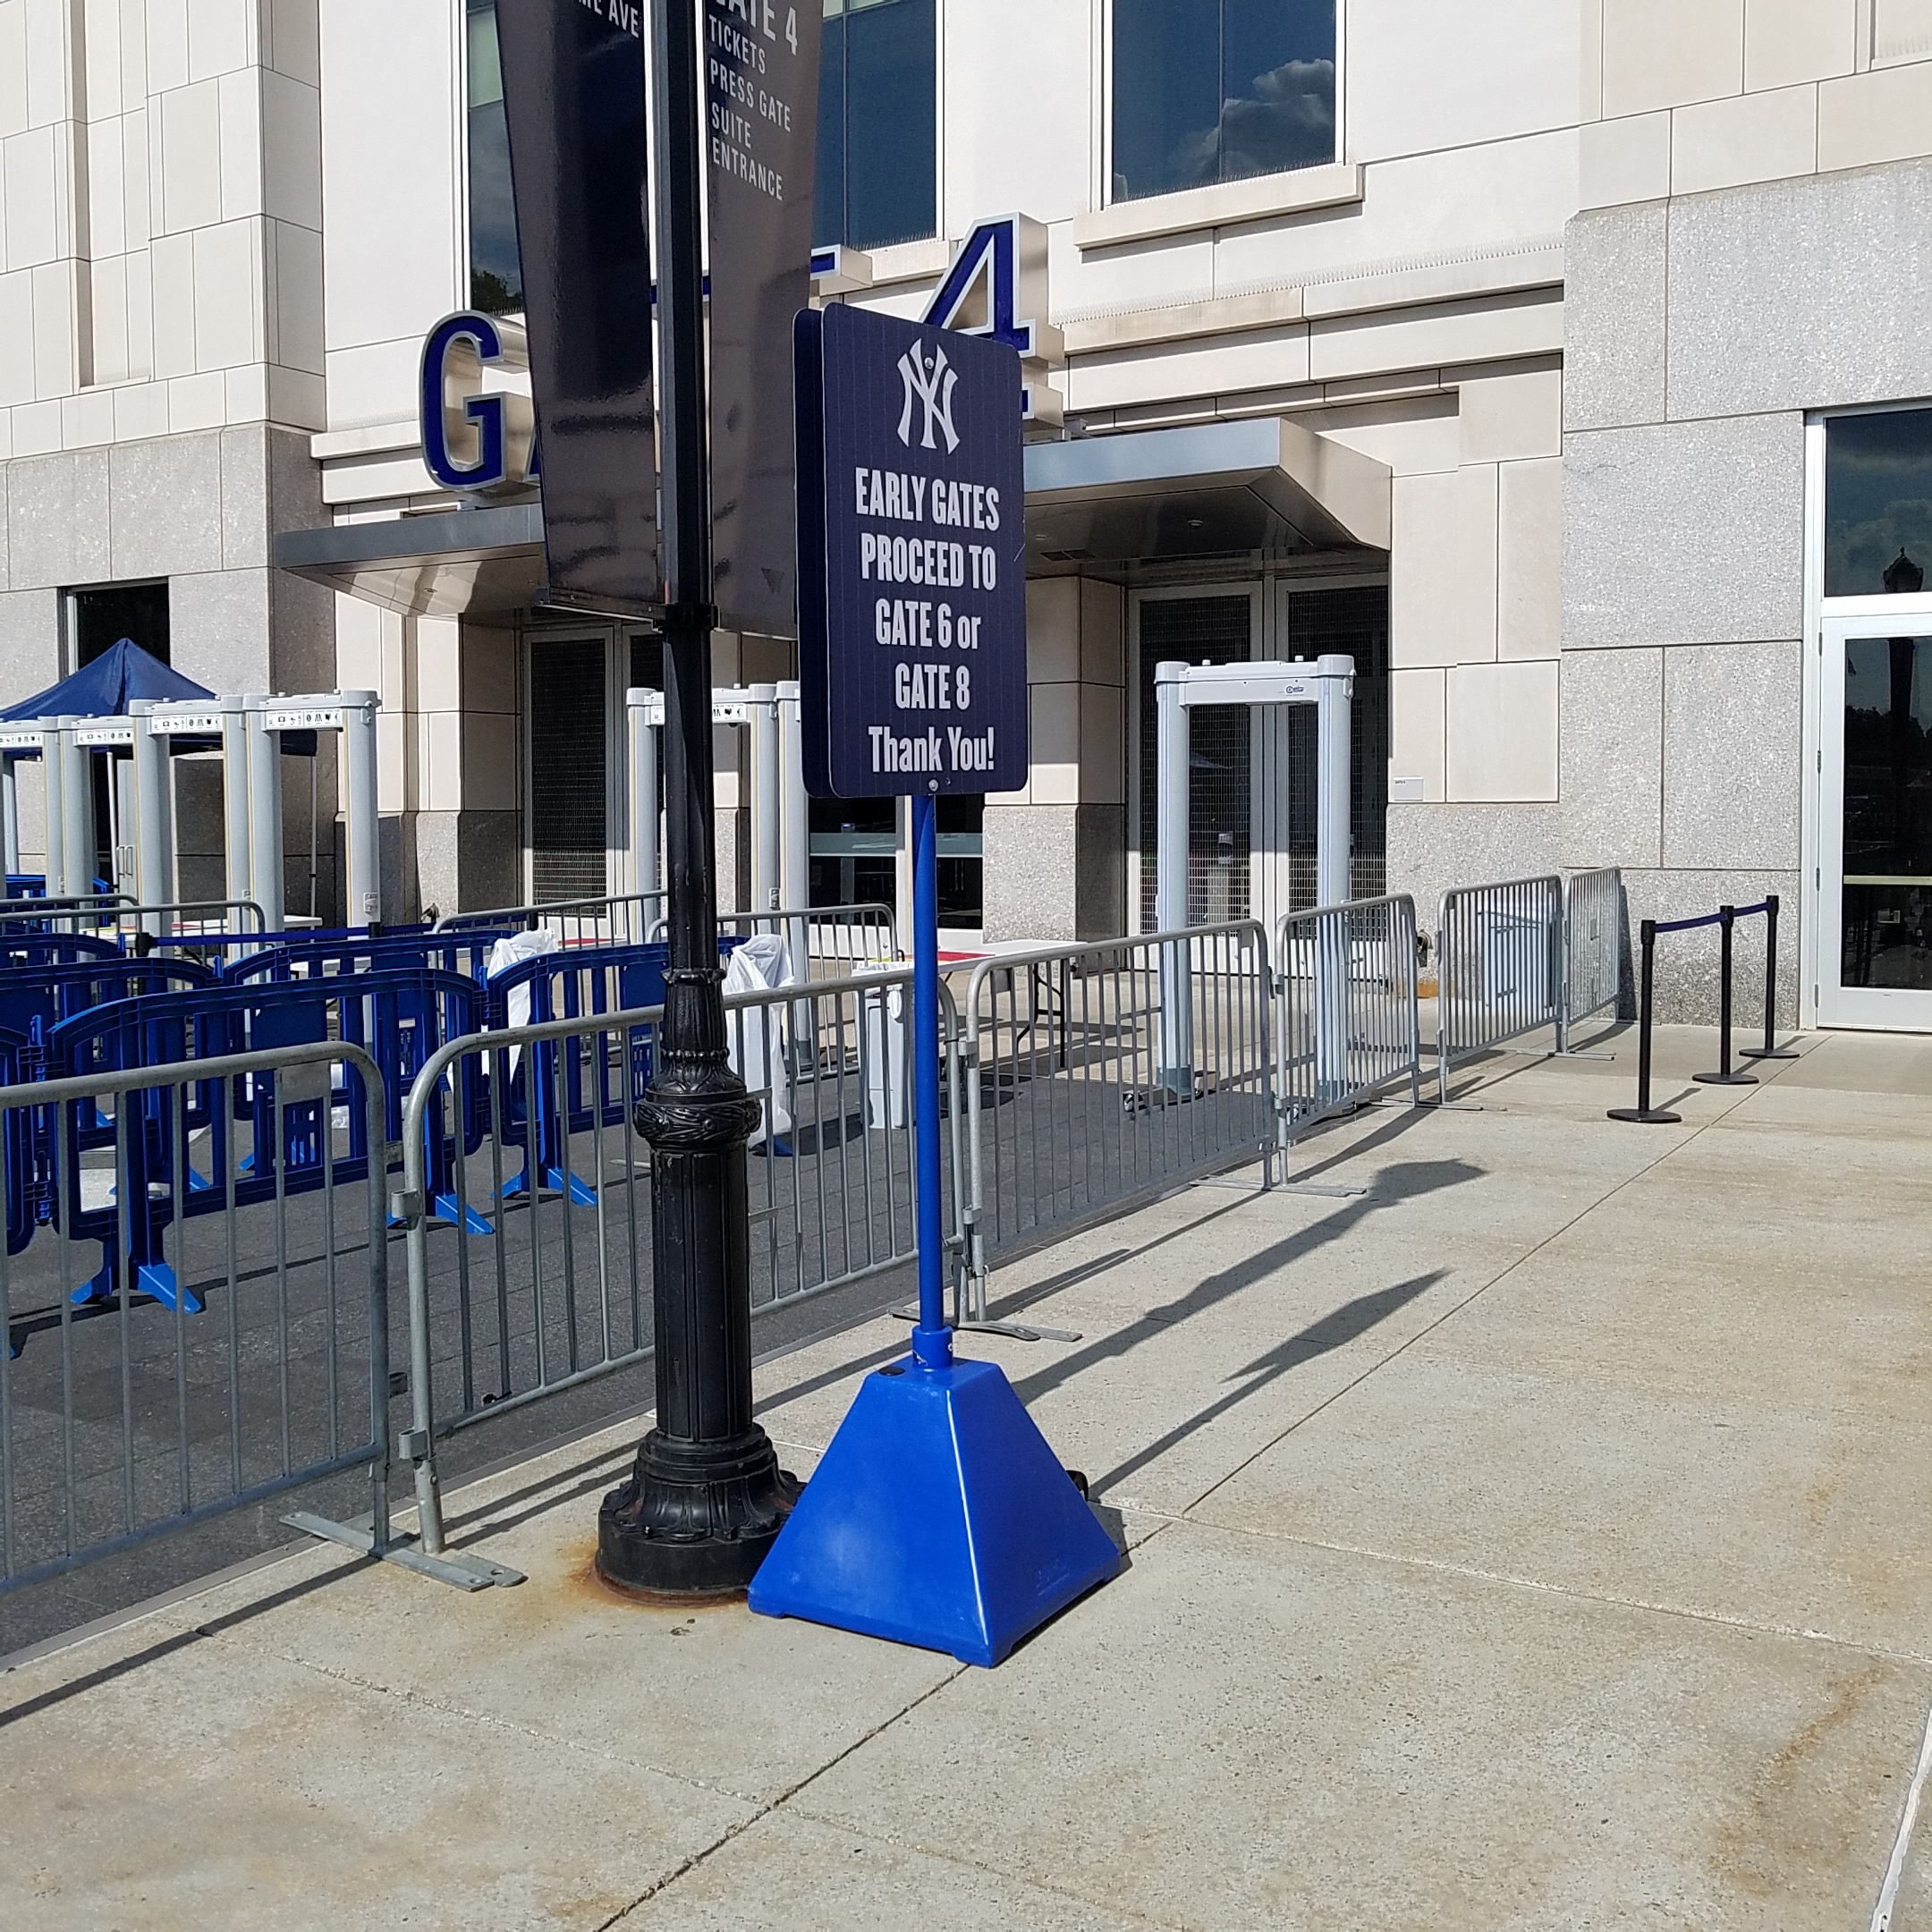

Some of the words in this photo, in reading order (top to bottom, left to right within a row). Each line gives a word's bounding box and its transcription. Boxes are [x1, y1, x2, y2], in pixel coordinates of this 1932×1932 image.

[608, 0, 639, 38] AVE
[708, 13, 766, 75] TICKETS
[785, 6, 798, 56] 4
[710, 57, 754, 108] PRESS
[759, 89, 791, 132] GATE
[711, 101, 751, 149] SUITE
[712, 136, 783, 201] ENTRANCE
[919, 211, 1036, 419] 4
[855, 467, 926, 521] EARLY
[931, 479, 1000, 531] GATES
[860, 532, 964, 587] PROCEED
[969, 544, 996, 590] TO
[875, 598, 933, 647] GATE
[937, 603, 952, 648] 6
[957, 615, 981, 649] or
[894, 663, 951, 709] GATE
[956, 665, 970, 710] 8
[868, 725, 943, 772] Thank
[947, 726, 994, 770] You!
